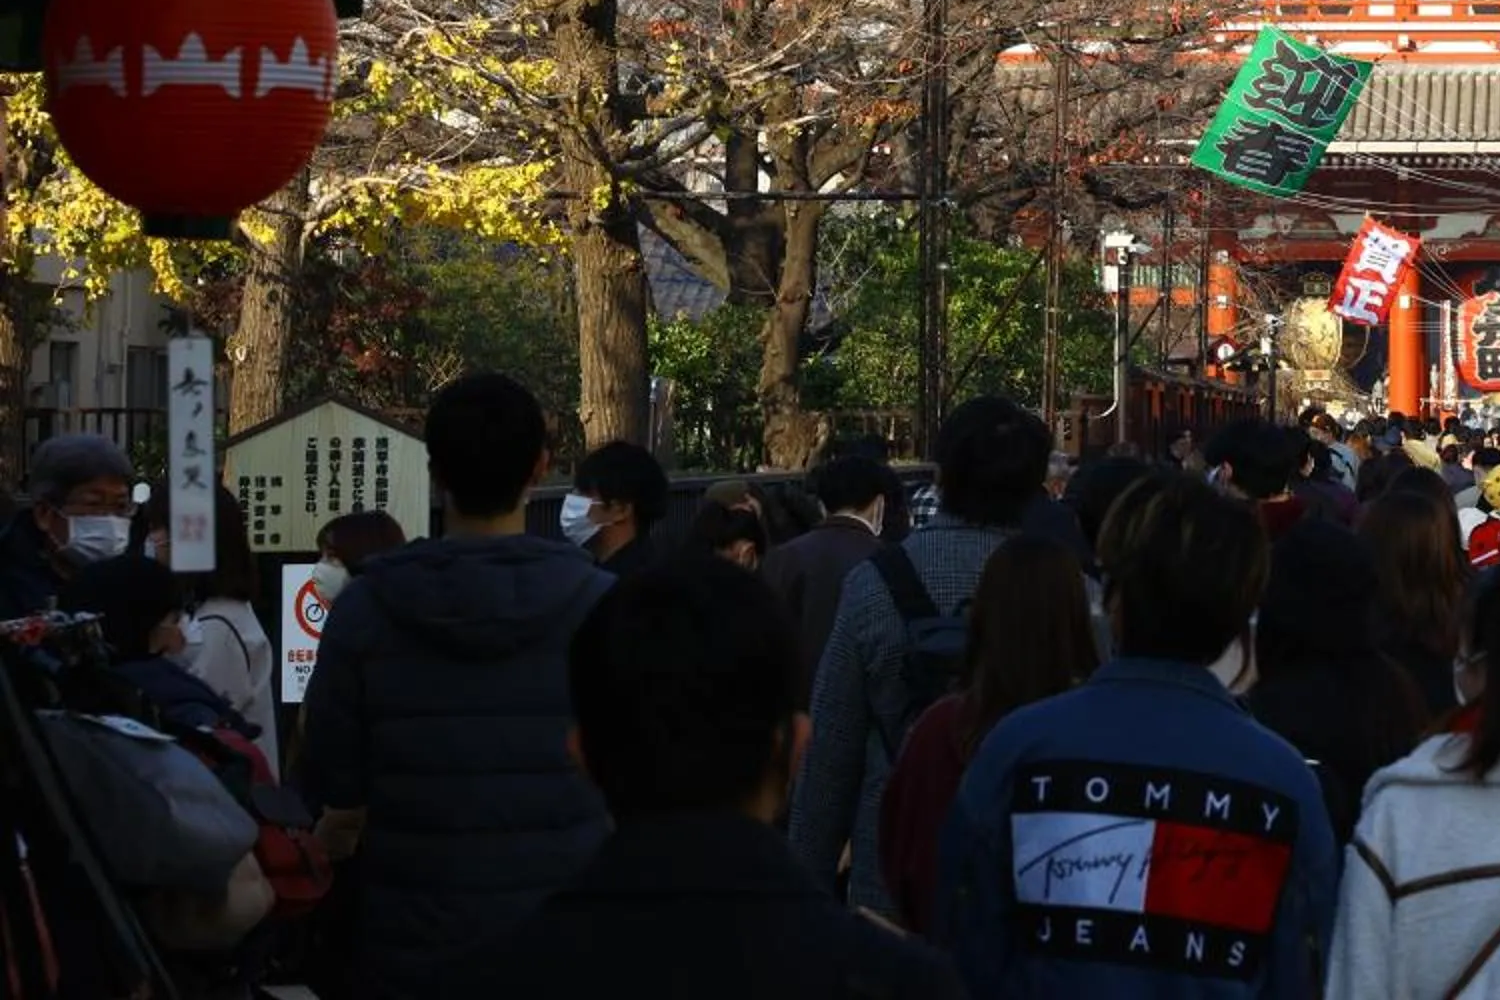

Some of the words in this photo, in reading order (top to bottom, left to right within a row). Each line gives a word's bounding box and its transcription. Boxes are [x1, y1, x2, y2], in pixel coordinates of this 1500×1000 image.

[1333, 227, 1411, 325] 賀正
[1031, 776, 1280, 831] TOMMY
[1038, 919, 1246, 967] JEANS
